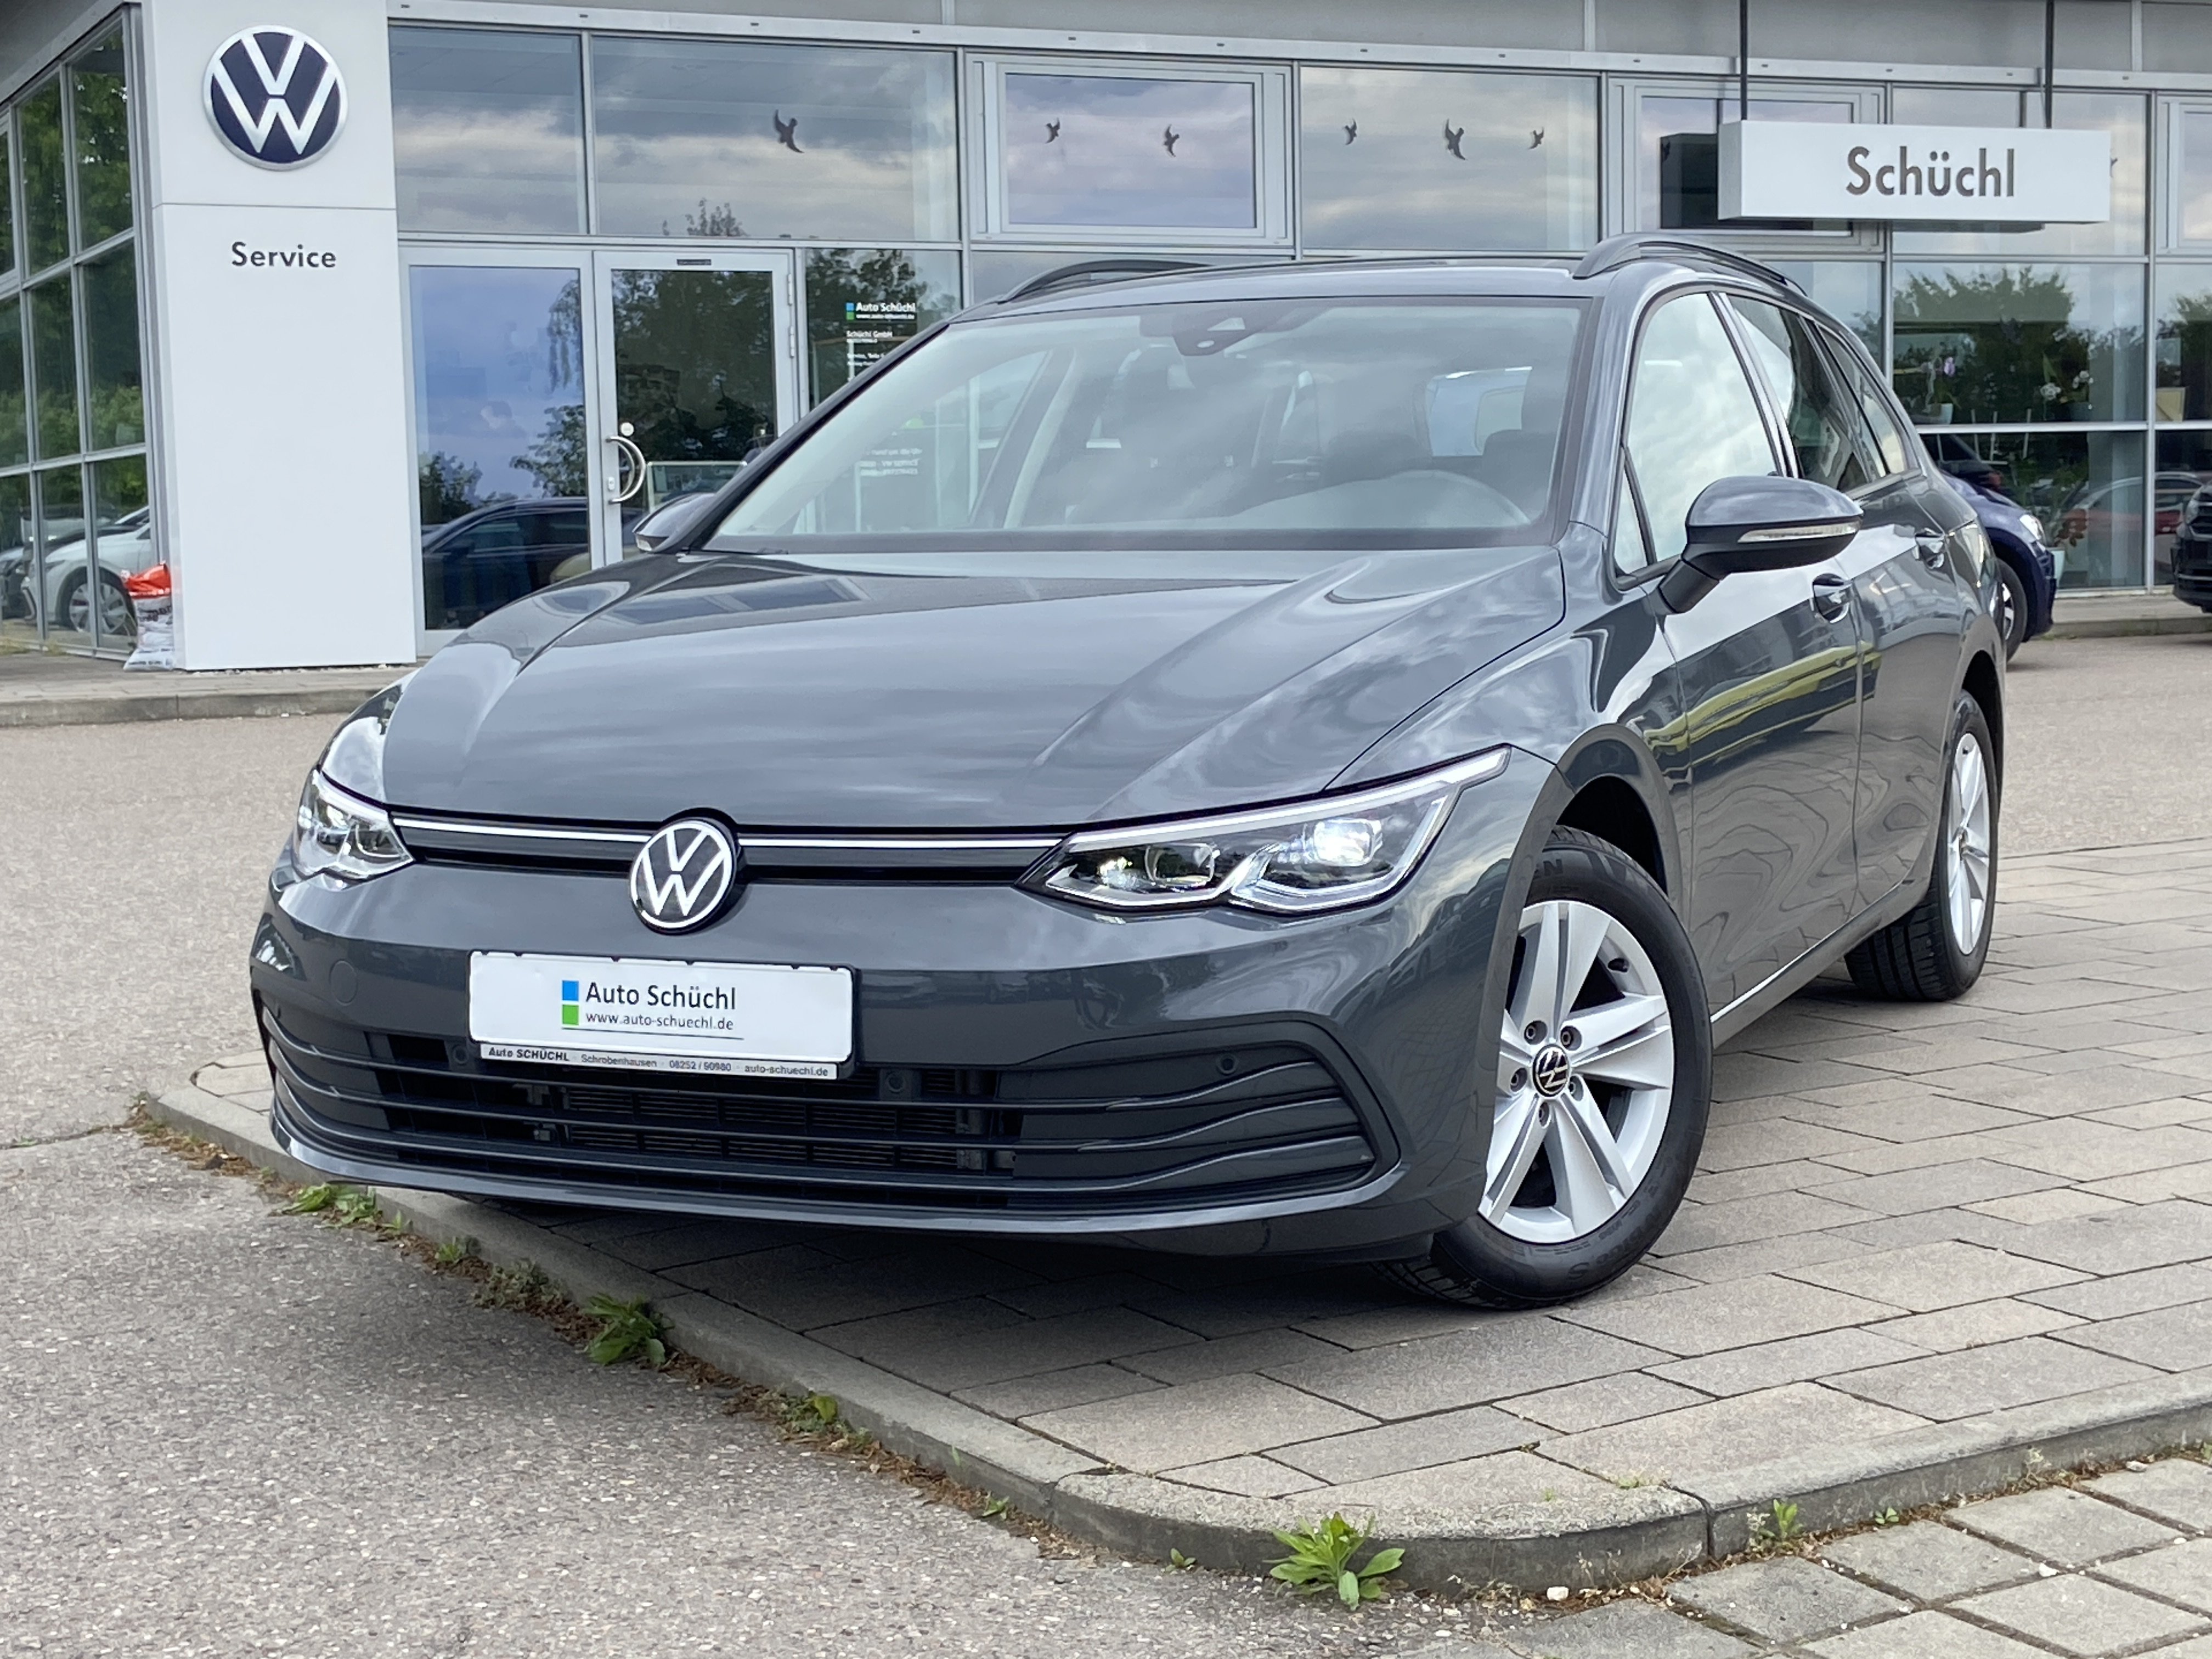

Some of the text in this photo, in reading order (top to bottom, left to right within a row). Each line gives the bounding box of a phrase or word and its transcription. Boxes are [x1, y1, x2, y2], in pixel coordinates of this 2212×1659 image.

[210, 29, 340, 158] VW
[1846, 145, 2015, 197] Schüchl
[231, 241, 336, 268] Service
[856, 302, 916, 312] Auto Schüchl
[637, 827, 727, 918] VW
[585, 981, 736, 1010] Auto Schüchl
[585, 1013, 734, 1030] www.auto-schuechl.de
[488, 1047, 513, 1058] Auto
[516, 1047, 570, 1062] SCHÜCHL
[580, 1053, 658, 1068] Schrobenhausen
[744, 1064, 829, 1077] auto-schuechl.de
